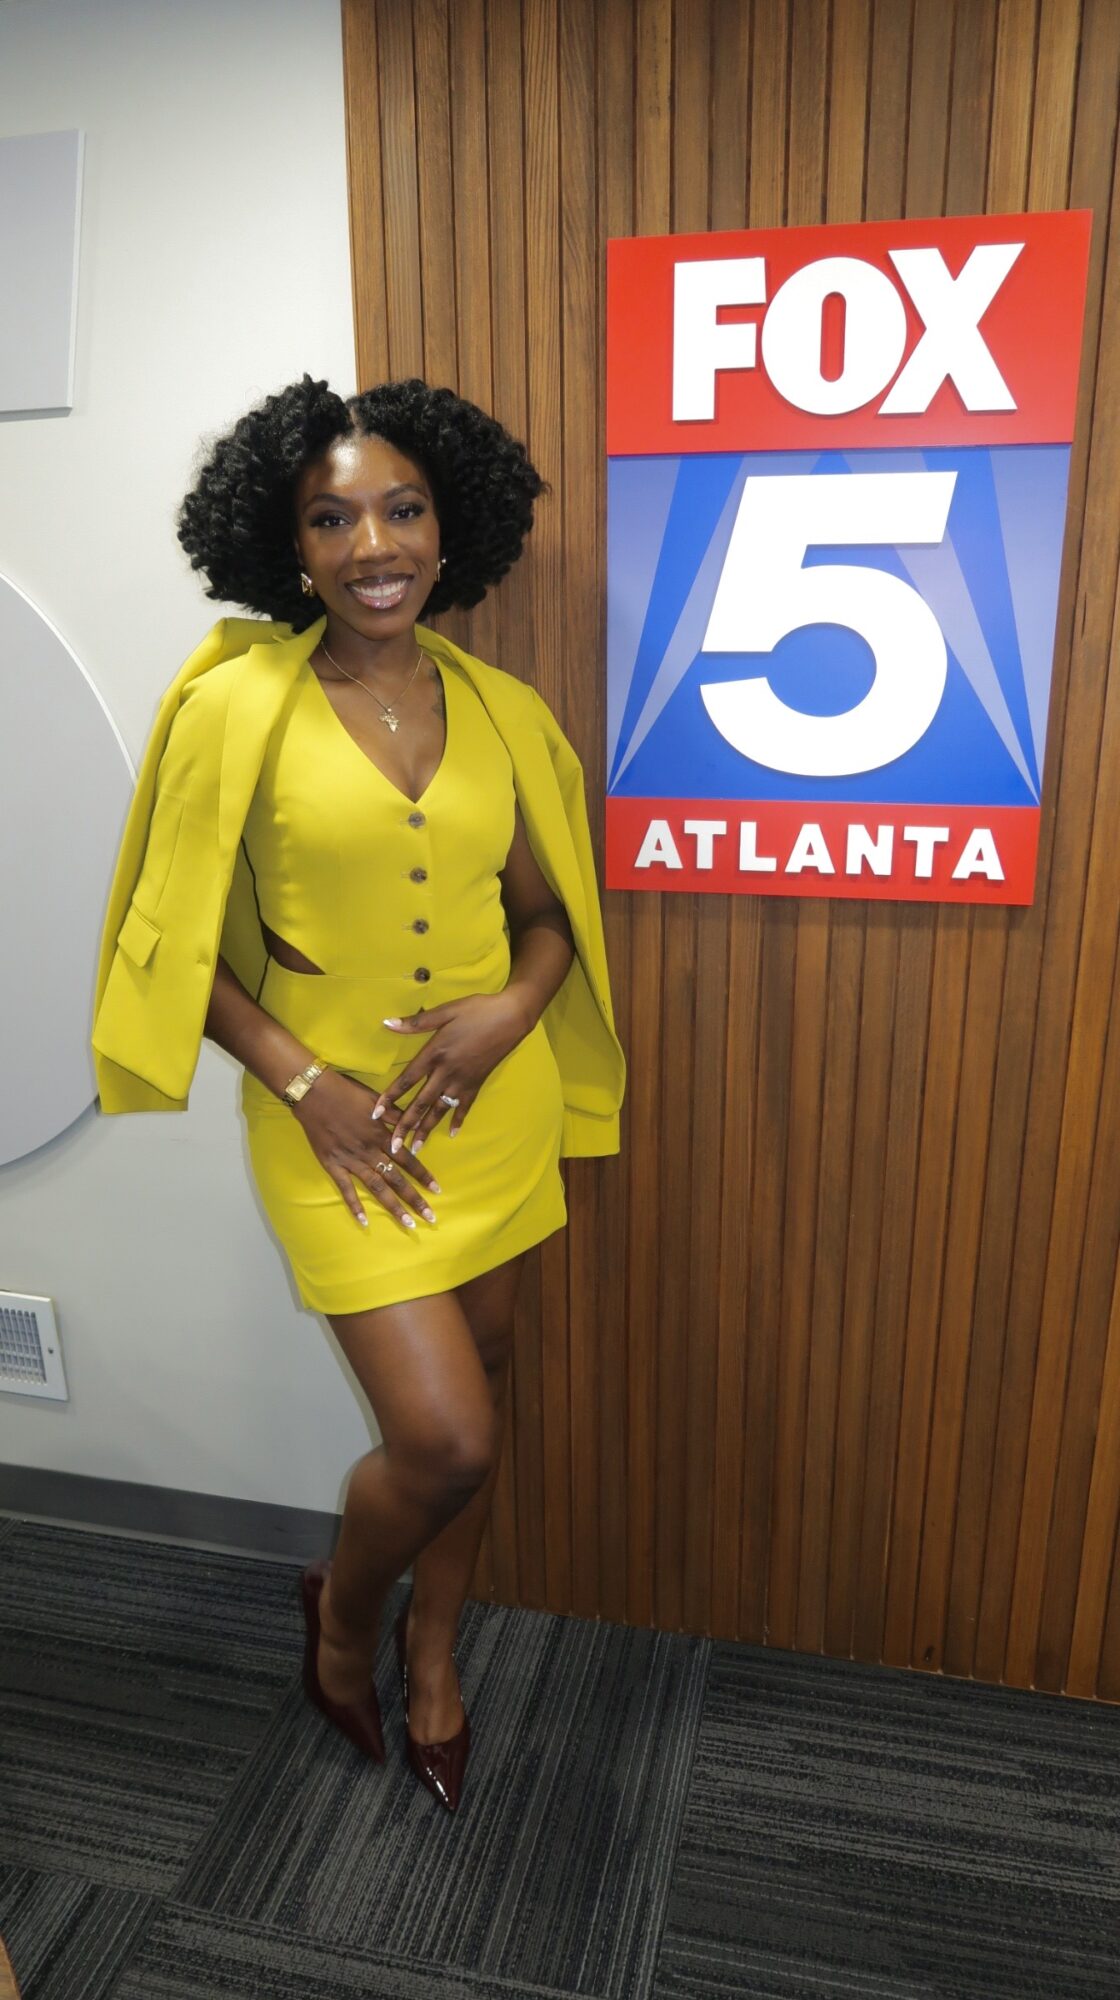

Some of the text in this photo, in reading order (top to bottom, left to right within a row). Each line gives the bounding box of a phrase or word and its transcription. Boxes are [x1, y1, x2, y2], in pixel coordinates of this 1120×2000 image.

[672, 243, 1025, 421] FOX
[699, 471, 958, 777] 5
[634, 819, 1005, 881] ATLANTA
